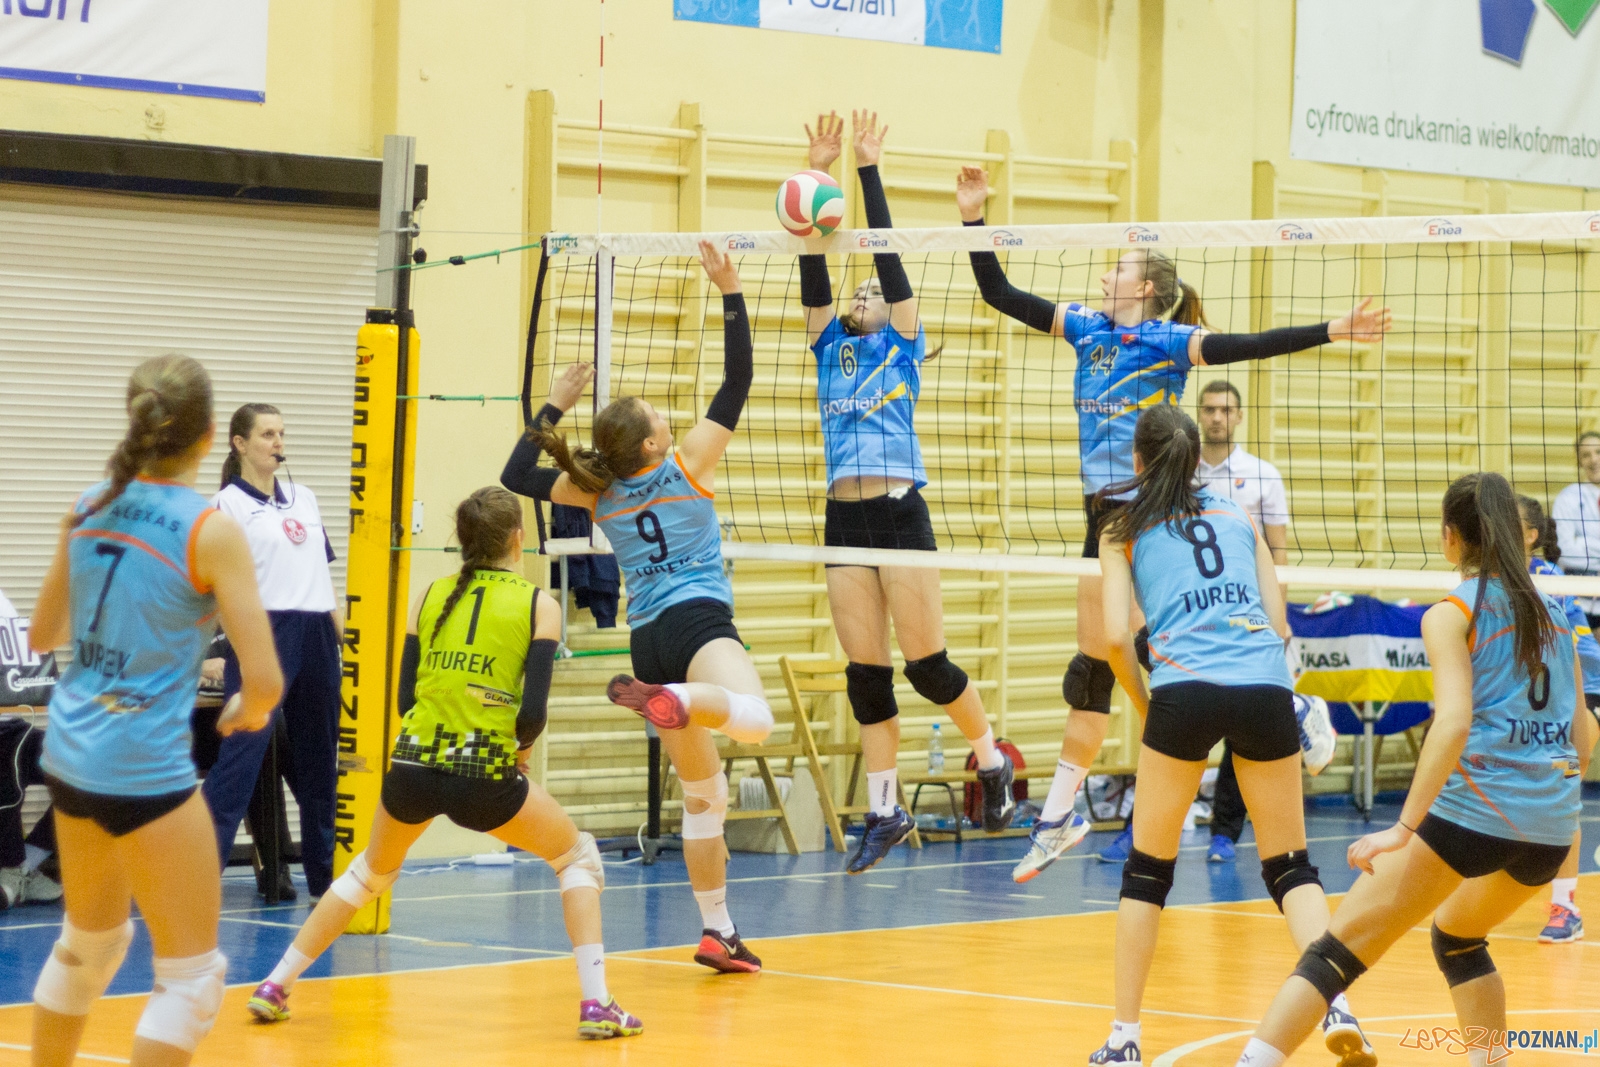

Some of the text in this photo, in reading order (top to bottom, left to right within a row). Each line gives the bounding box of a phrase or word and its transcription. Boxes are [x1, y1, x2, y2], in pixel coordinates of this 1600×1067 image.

[1306, 103, 1600, 158] cyfrowa drukarnia wielkoformato
[859, 237, 888, 248] Enea
[993, 235, 1023, 247] Enea
[1128, 231, 1159, 243] Enea
[1281, 229, 1313, 241] Enea
[1428, 224, 1462, 236] Enea
[728, 239, 755, 250] Enea
[839, 342, 857, 379] 6
[1090, 345, 1119, 376] 14
[111, 505, 181, 532] ALEXAS
[635, 510, 669, 564] 9
[1186, 519, 1225, 579] 8
[95, 542, 127, 632] 7
[1180, 583, 1250, 613] TUREK
[465, 586, 487, 646] 1
[431, 650, 497, 678] TUREK
[1385, 644, 1431, 668] MiKA
[1506, 717, 1570, 746] TUREK
